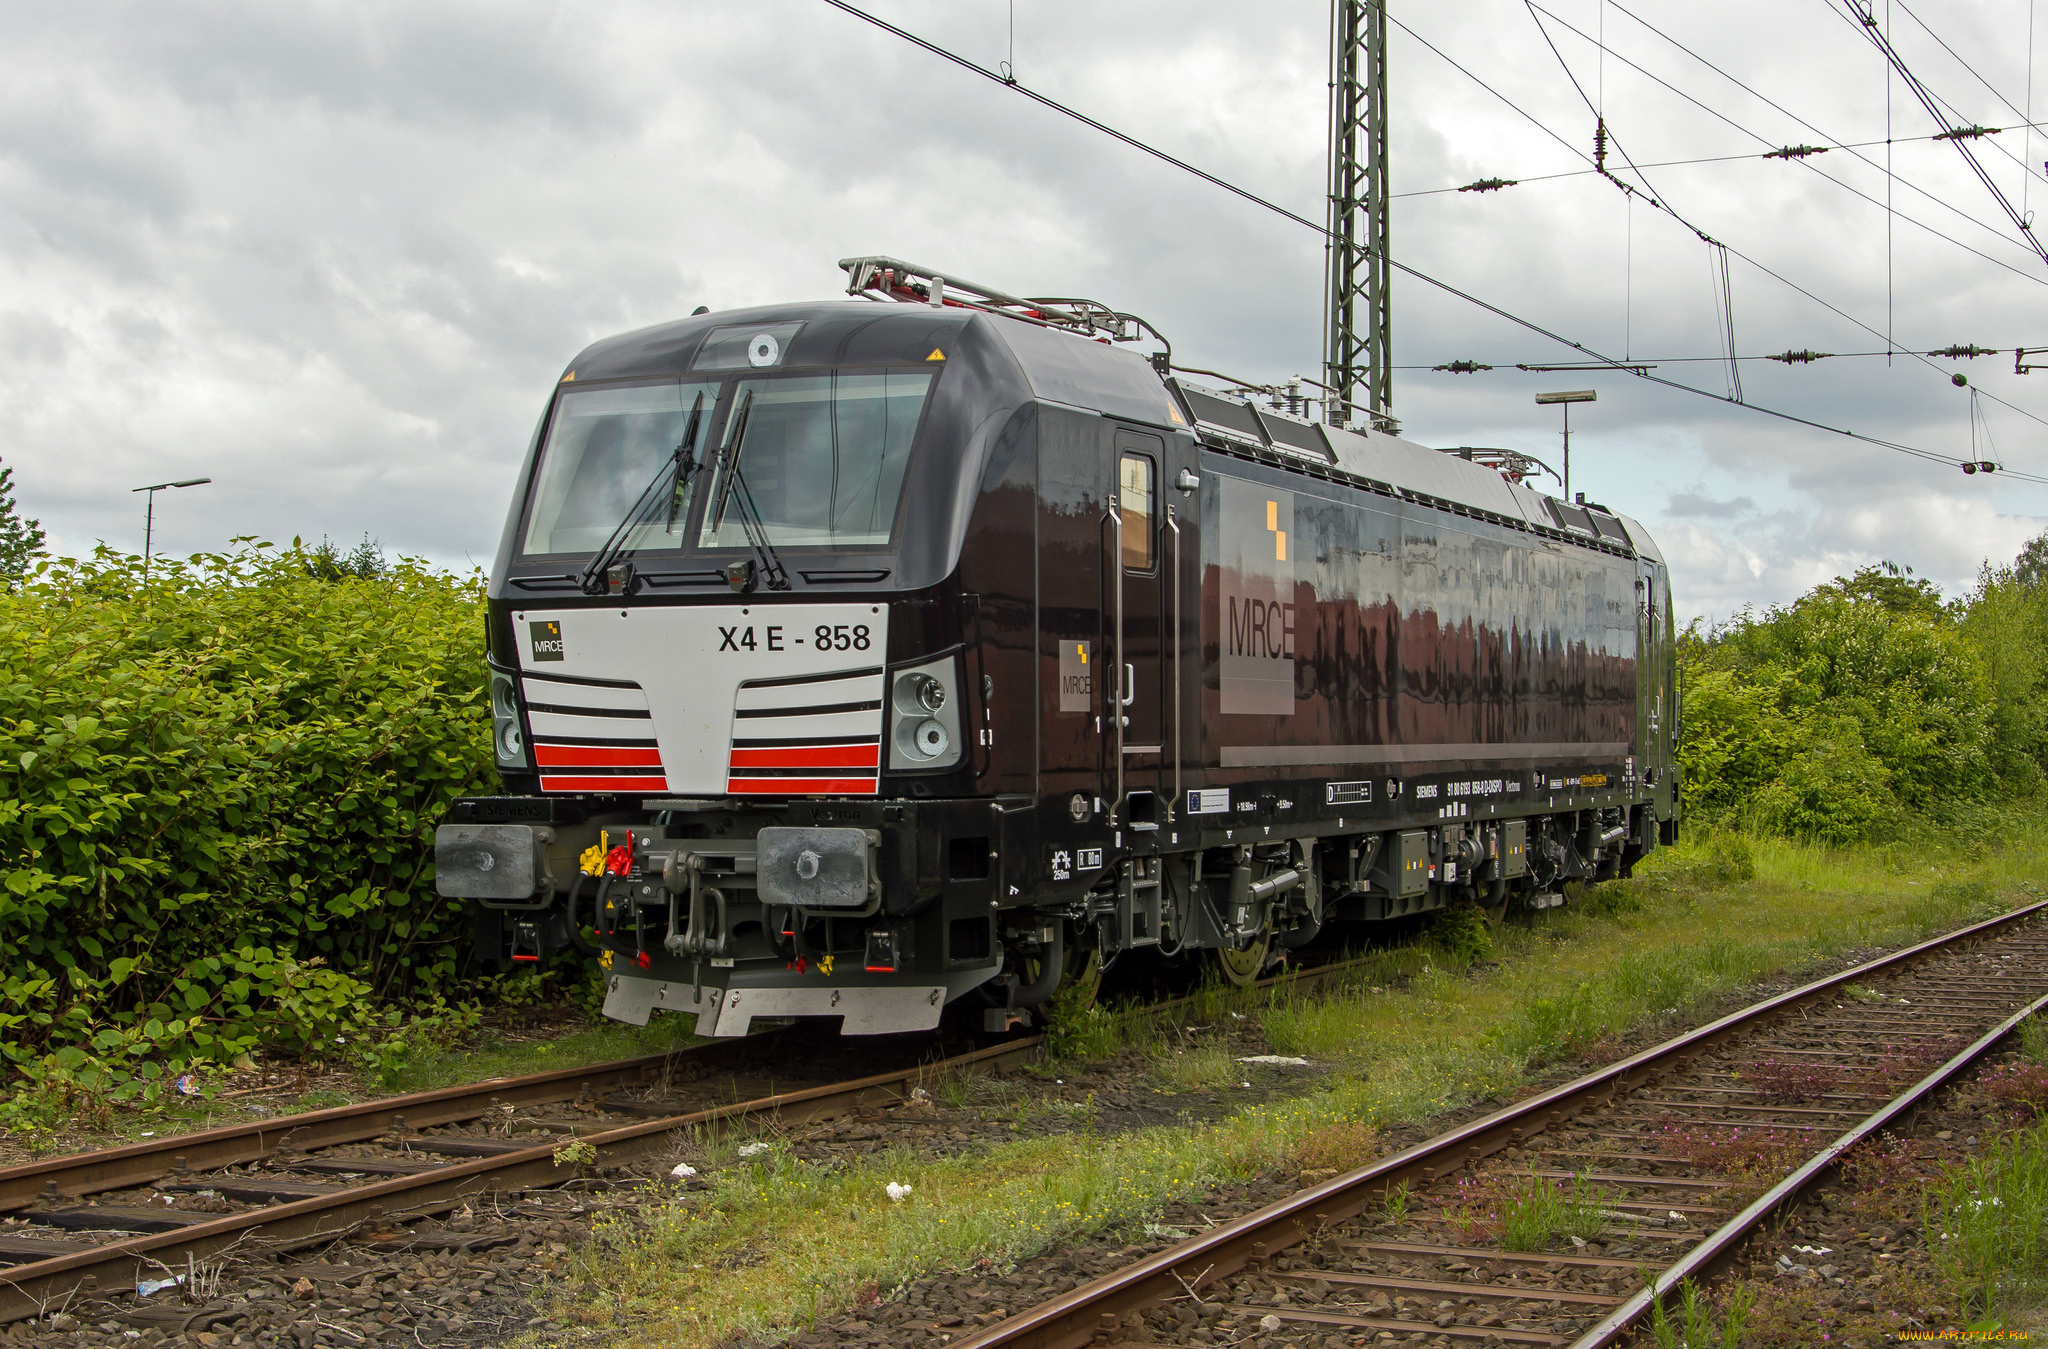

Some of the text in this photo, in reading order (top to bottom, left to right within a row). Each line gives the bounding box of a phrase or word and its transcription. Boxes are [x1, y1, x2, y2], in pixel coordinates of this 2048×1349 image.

[1229, 596, 1295, 660] MRCE
[718, 626, 757, 651] X4
[767, 626, 784, 651] E
[814, 625, 871, 651] 858
[534, 640, 563, 652] MRCE
[1063, 675, 1091, 694] MRCE
[1328, 785, 1334, 802] D
[1416, 784, 1438, 799] SIEMENS
[1447, 783, 1454, 797] 91
[487, 804, 541, 816] SIEMENS
[1053, 870, 1070, 880] 250m
